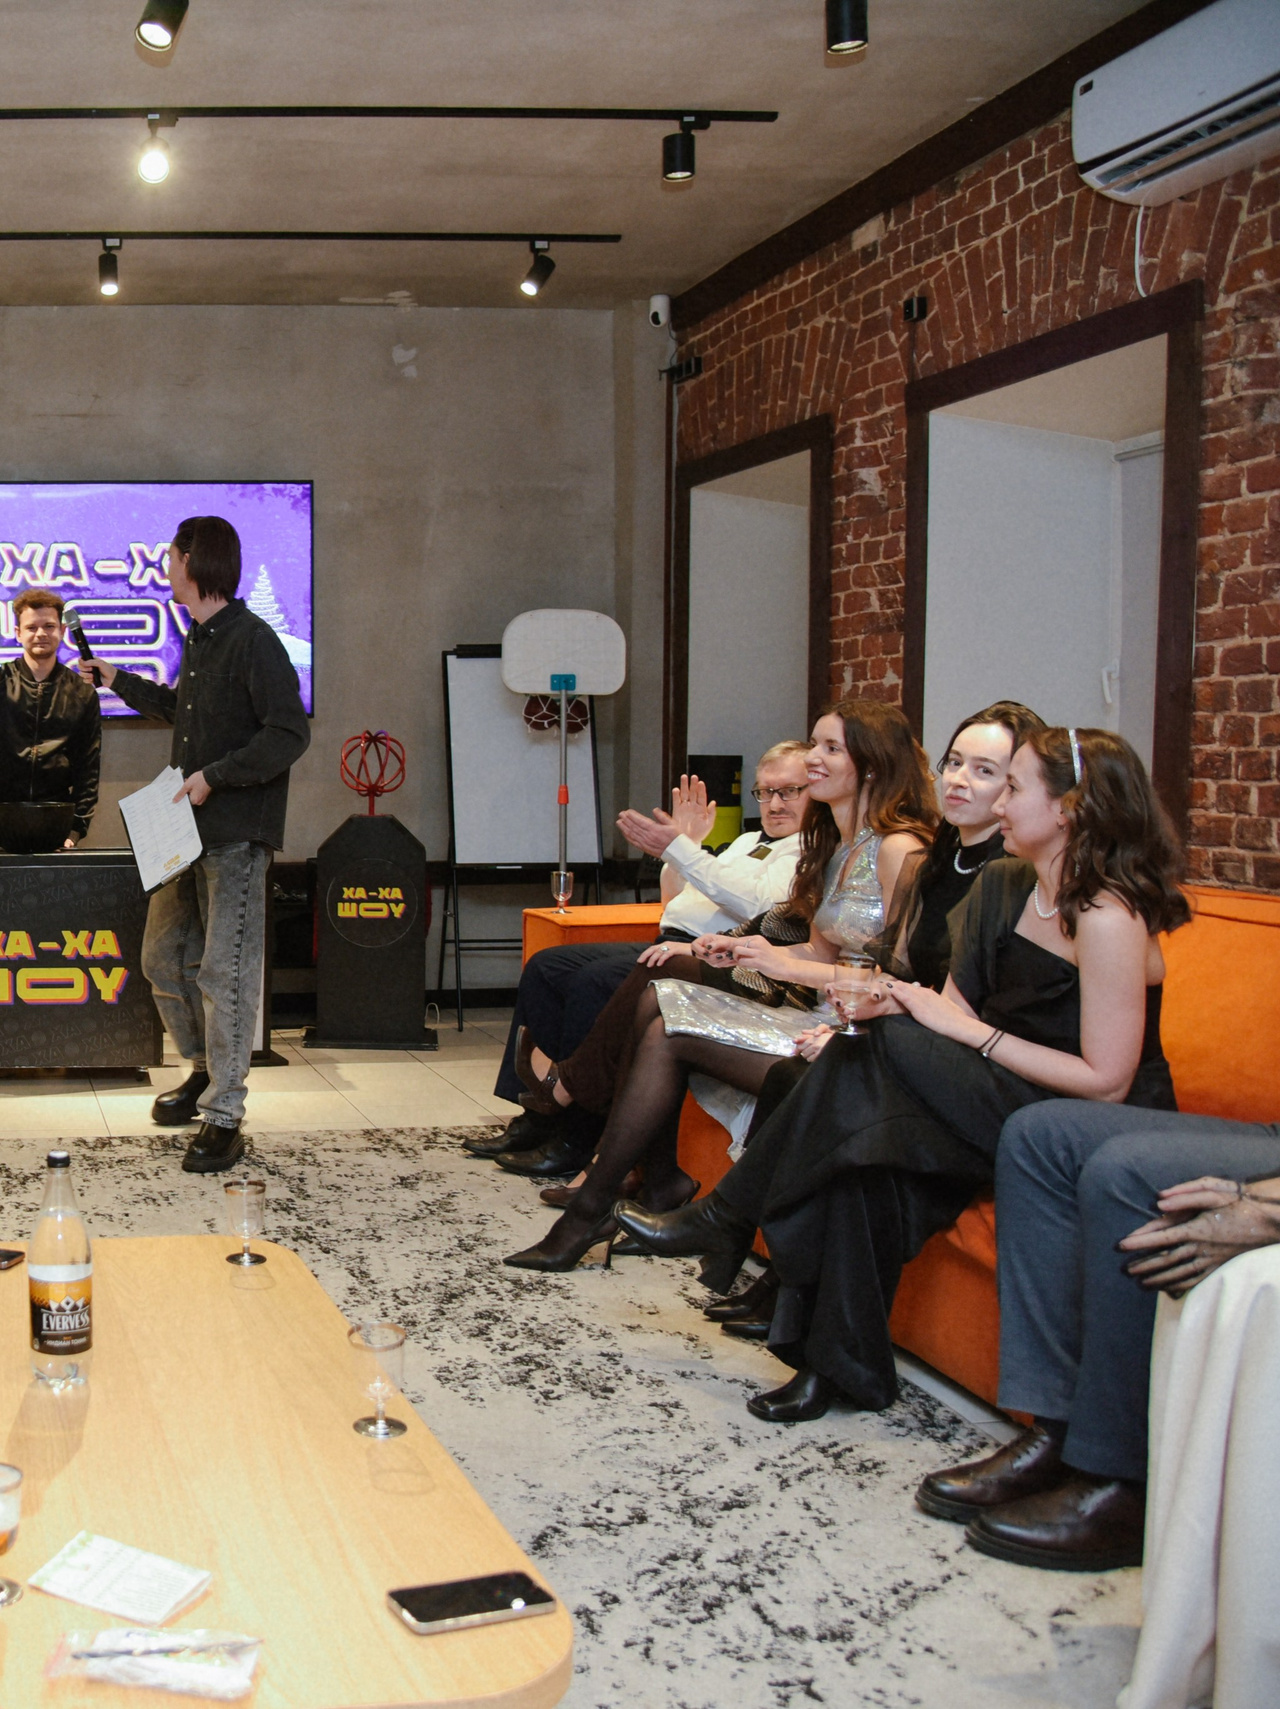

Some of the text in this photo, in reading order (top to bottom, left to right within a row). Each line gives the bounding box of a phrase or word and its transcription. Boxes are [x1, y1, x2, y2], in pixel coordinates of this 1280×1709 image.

[342, 887, 404, 900] ХА-ХА
[337, 902, 407, 918] ШОУ
[43, 1310, 89, 1330] EVERVESS
